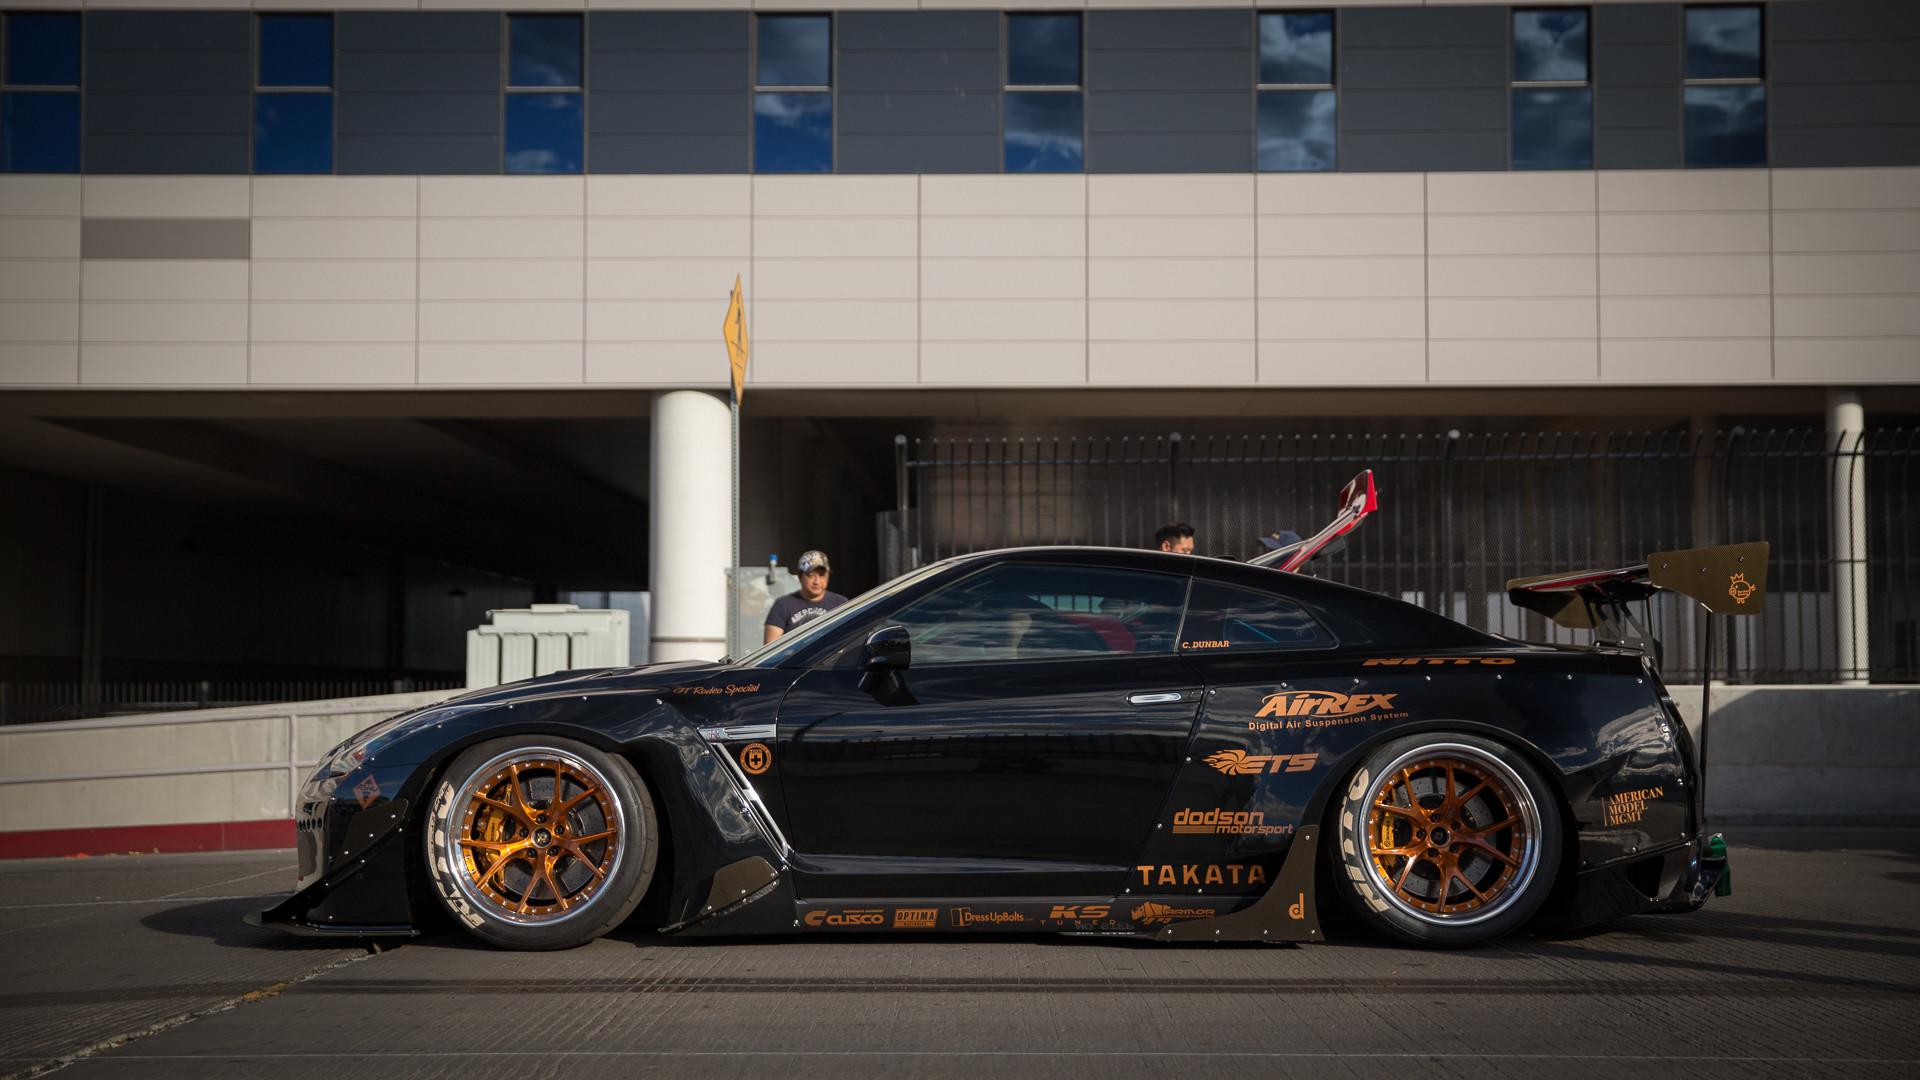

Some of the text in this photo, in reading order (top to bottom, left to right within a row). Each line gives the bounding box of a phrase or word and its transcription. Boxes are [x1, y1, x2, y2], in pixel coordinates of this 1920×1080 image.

[1182, 640, 1230, 649] C. DUNBAR
[1362, 657, 1516, 666] NITTO
[693, 686, 723, 695] Rodeo
[725, 683, 760, 696] Special
[1248, 712, 1409, 731] Digital Air Suspension System
[1241, 752, 1319, 774] ETS
[1608, 786, 1664, 805] AMERICAN
[1608, 800, 1649, 816] MODEL
[1173, 807, 1265, 826] dodson
[1610, 810, 1643, 827] MGMT
[1216, 823, 1295, 836] motorsport
[1136, 864, 1266, 886] TAKATA
[1288, 892, 1305, 920] d
[897, 911, 935, 921] OPTIMA
[964, 911, 1024, 924] DressUpBolts
